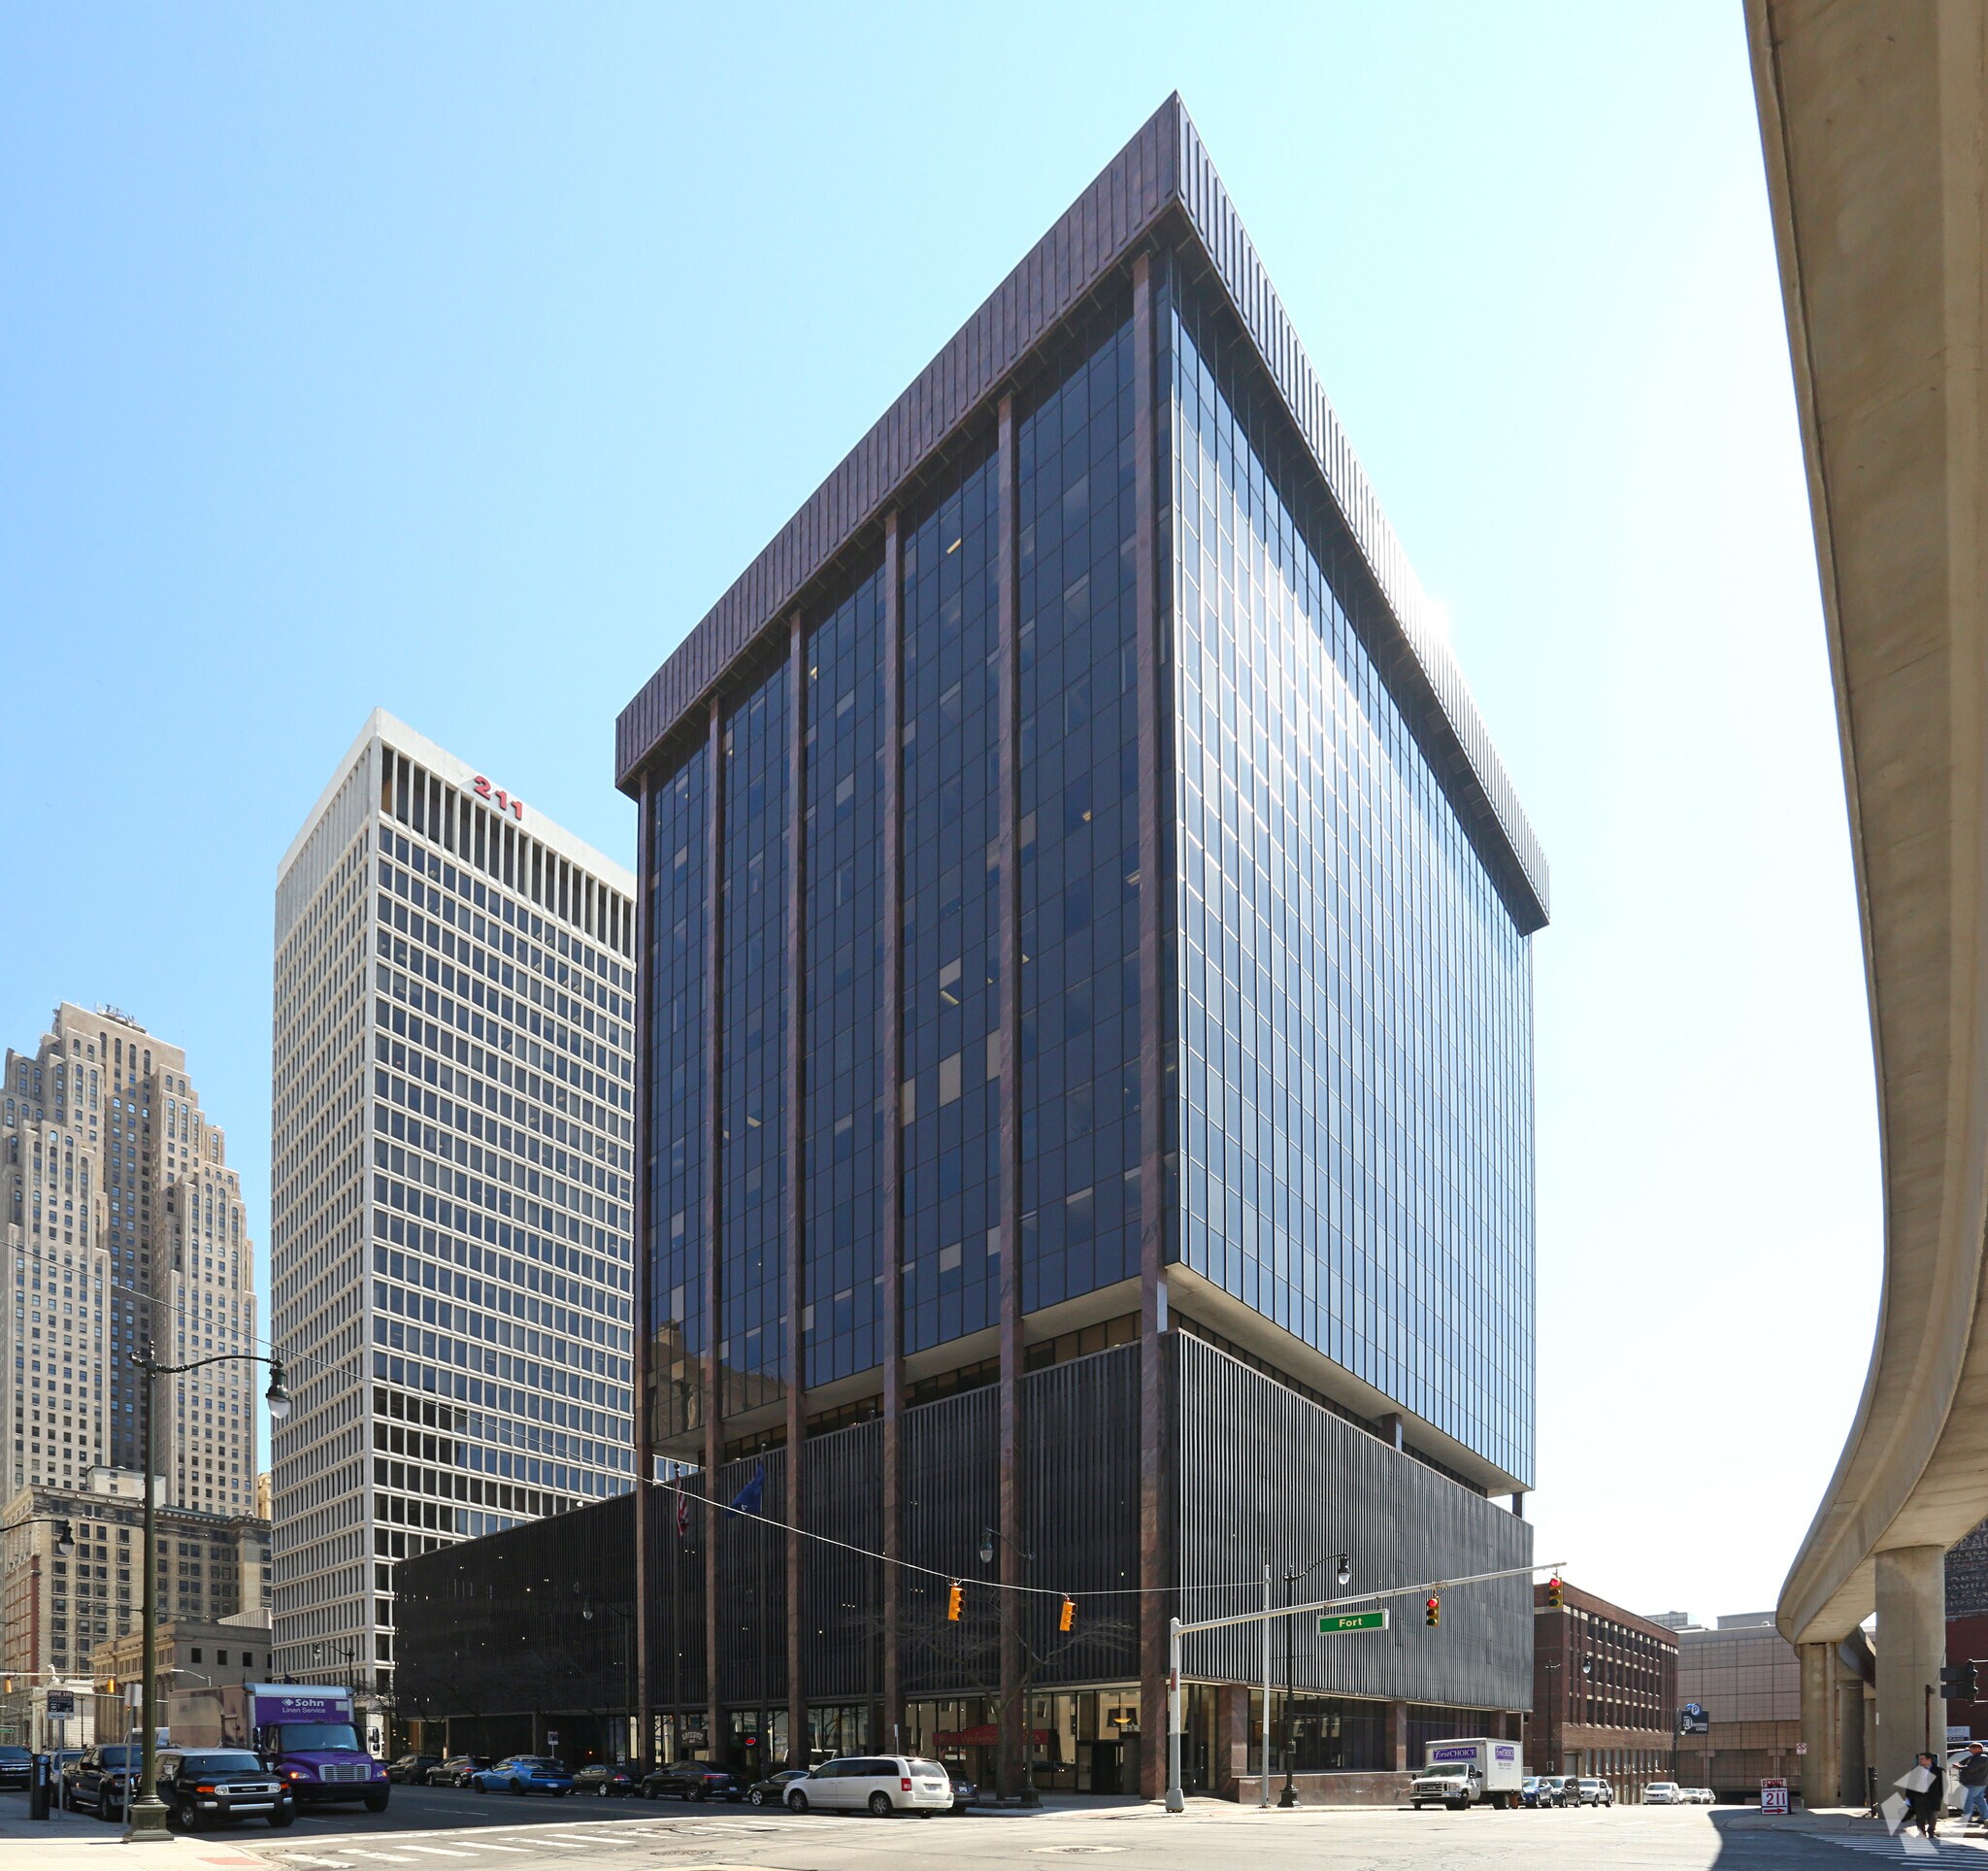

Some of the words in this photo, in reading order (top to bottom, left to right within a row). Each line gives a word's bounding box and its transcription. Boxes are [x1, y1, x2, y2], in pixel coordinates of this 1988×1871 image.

[474, 775, 523, 821] 211
[1339, 1618, 1363, 1627] Fort
[1766, 1792, 1786, 1806] 211
